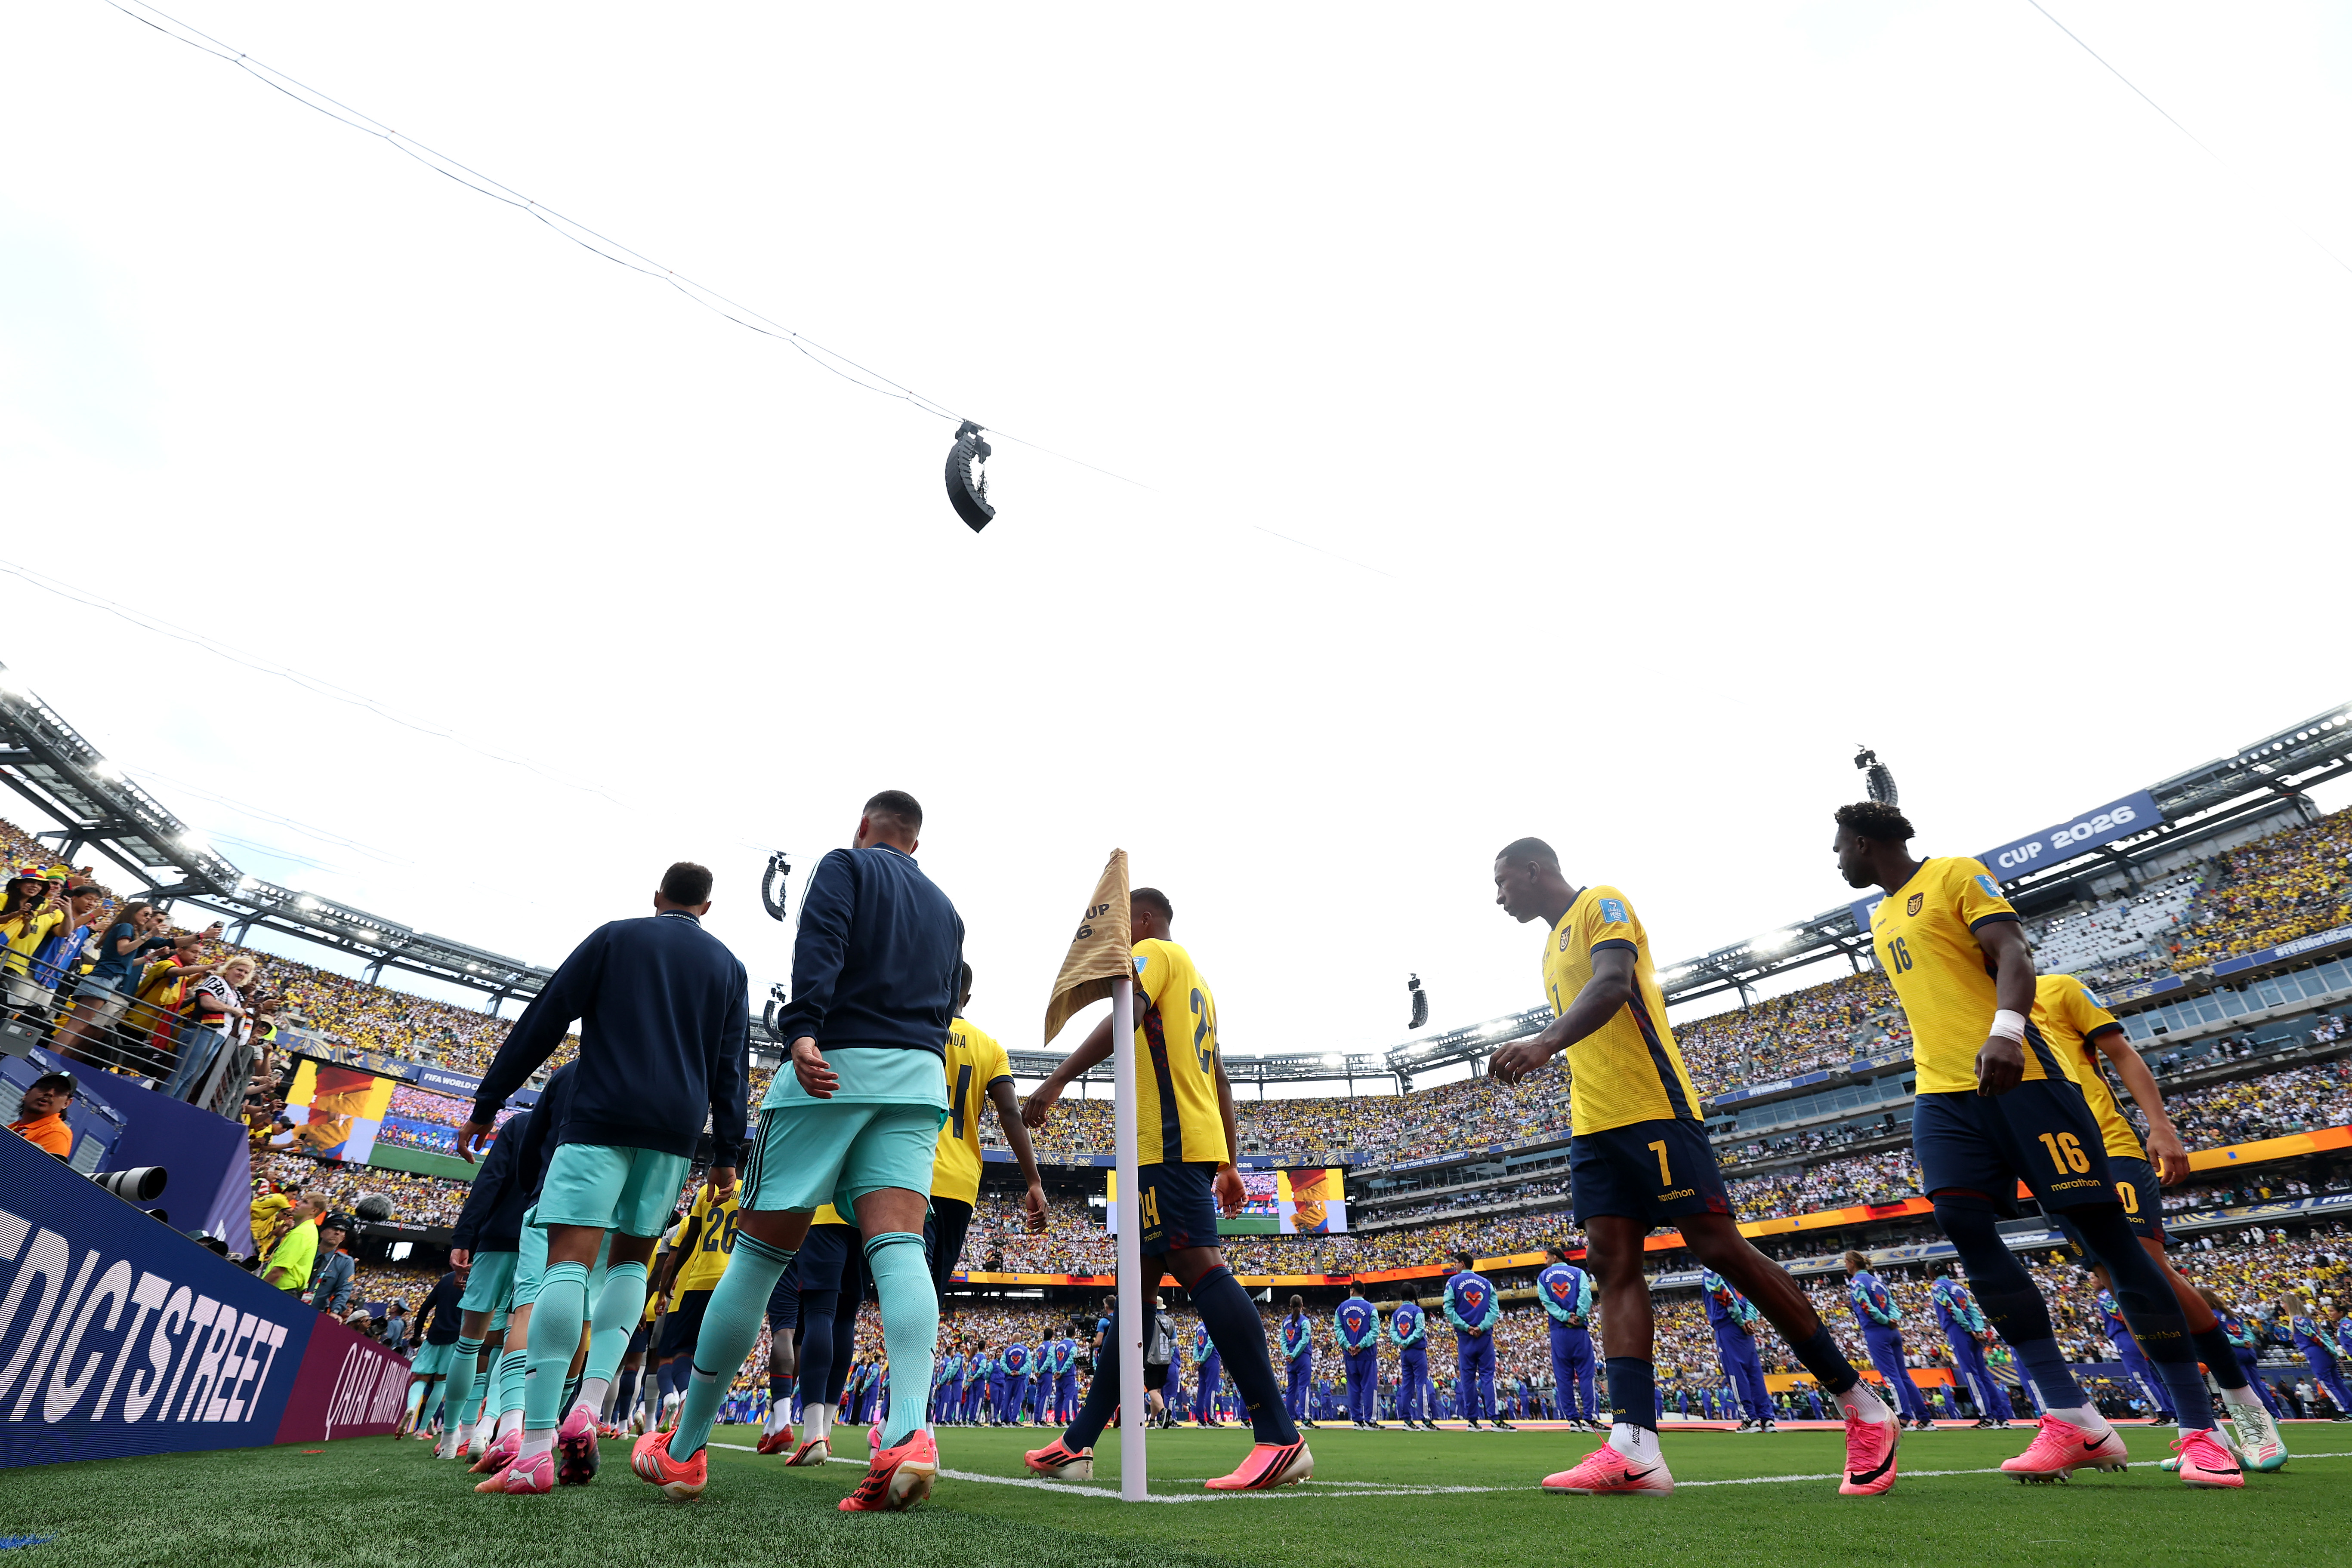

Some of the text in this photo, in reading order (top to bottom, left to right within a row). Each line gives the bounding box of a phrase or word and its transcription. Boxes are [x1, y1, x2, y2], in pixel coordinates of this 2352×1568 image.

[1998, 806, 2136, 868] CUP 2026
[674, 913, 696, 923] DEUTSCHLAND
[1081, 904, 1110, 924] UP
[1888, 936, 1913, 974] 16
[947, 1030, 966, 1049] NDA
[423, 1073, 442, 1083] FIFA
[442, 1077, 471, 1089] WORLD
[946, 1064, 972, 1140] 4
[1440, 1152, 1465, 1161] JERSEY
[1648, 1140, 1672, 1186] 7
[2038, 1132, 2090, 1175] 16
[1658, 1189, 1695, 1202] arathon
[2050, 1179, 2101, 1192] marathon
[1138, 1186, 1161, 1229] 24
[2115, 1181, 2139, 1214] 0
[702, 1207, 739, 1254] 26
[1458, 1278, 1486, 1291] VOLUNTEER
[1545, 1270, 1575, 1283] VOLUNTEER
[1342, 1306, 1366, 1317] VOLUNTEER
[324, 1342, 412, 1441] QATAR AIRWAYS
